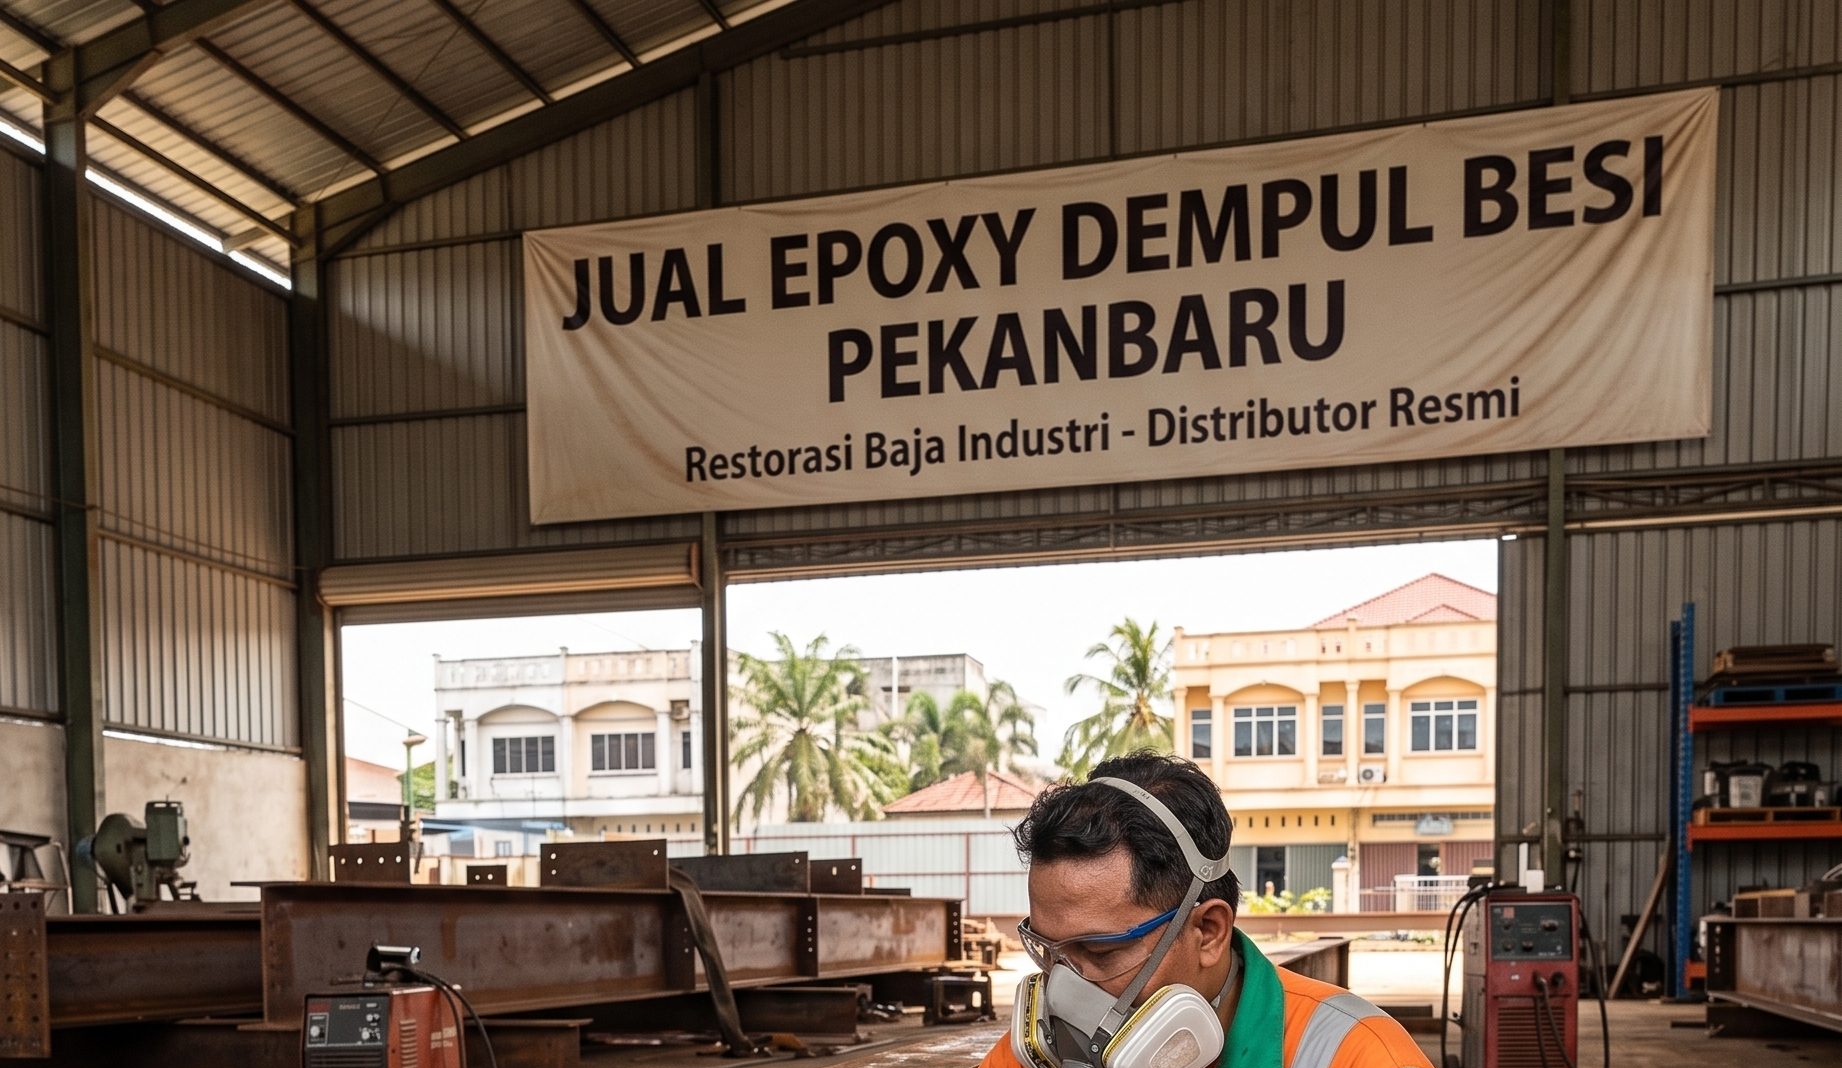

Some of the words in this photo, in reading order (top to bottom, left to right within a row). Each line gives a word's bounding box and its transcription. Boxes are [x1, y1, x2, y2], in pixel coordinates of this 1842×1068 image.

[562, 242, 747, 331] JUAL
[769, 208, 1035, 310] EPOXY
[1062, 166, 1434, 281] DEMPUL
[1464, 136, 1665, 238] BESI
[829, 280, 1347, 403] PEKANBARU
[686, 434, 853, 483] Restorasi
[865, 427, 945, 476] Baja
[958, 412, 1111, 462] Industri
[1148, 397, 1378, 448] Distributor
[1391, 377, 1521, 428] Resmi
